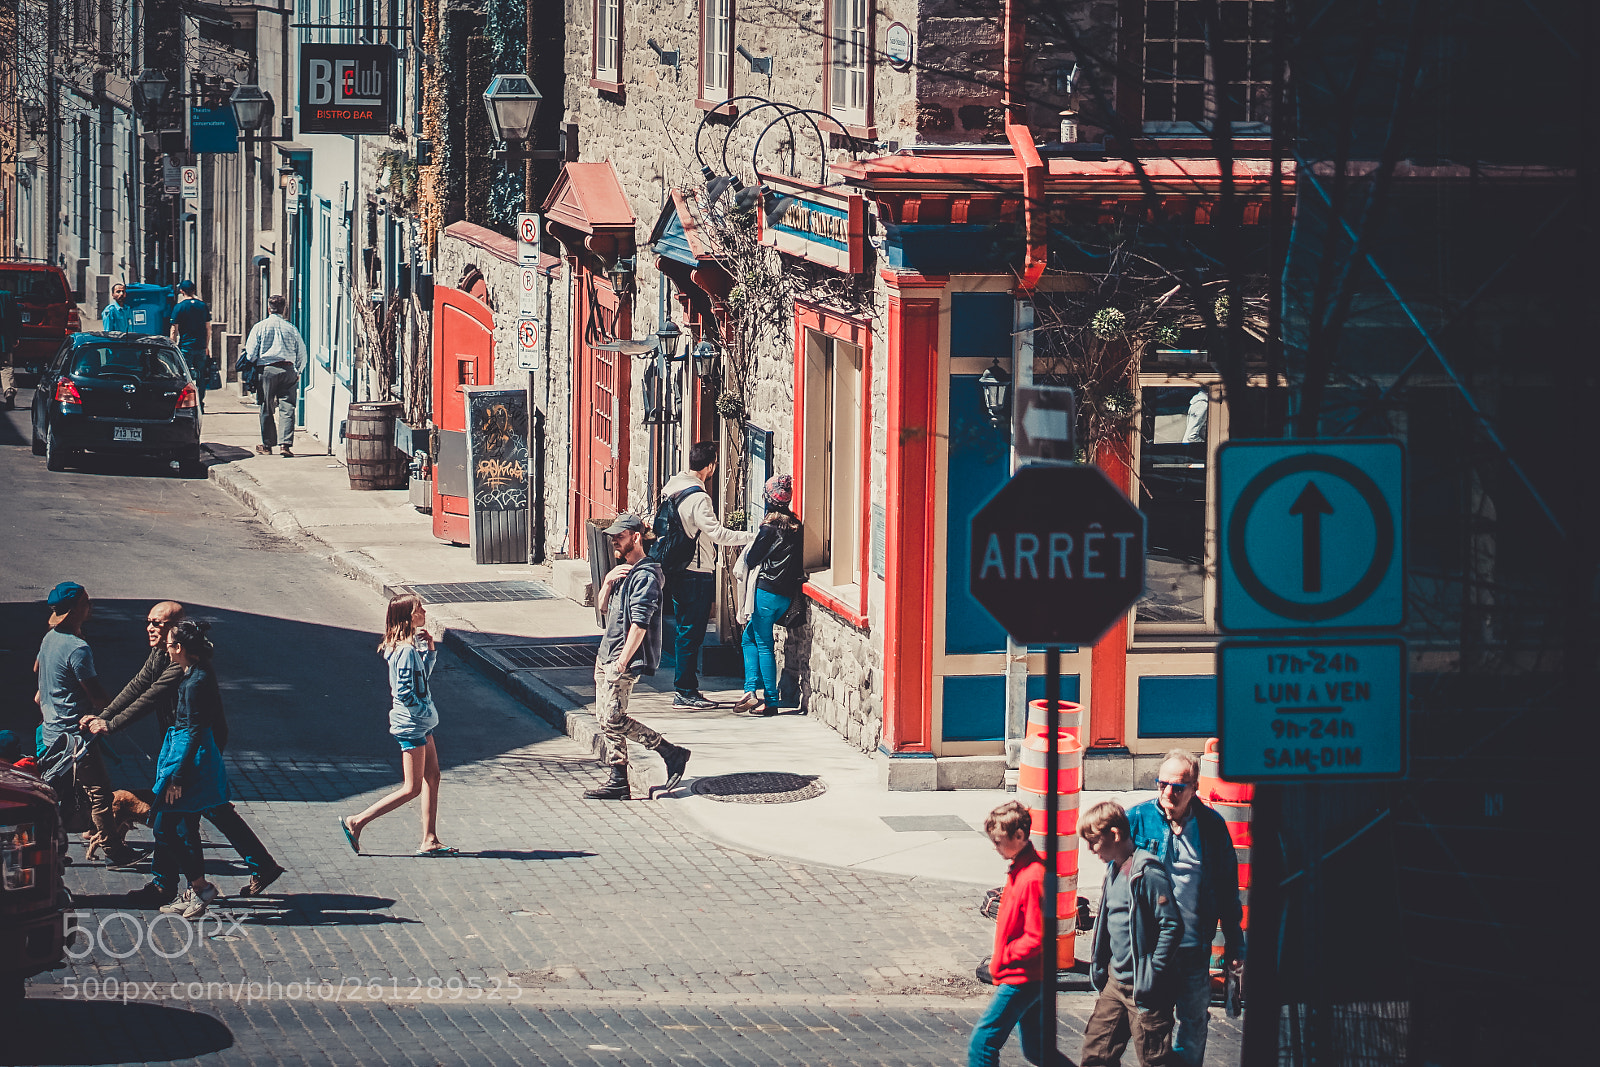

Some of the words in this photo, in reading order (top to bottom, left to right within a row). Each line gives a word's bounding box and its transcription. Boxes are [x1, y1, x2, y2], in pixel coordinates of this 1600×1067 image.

[317, 110, 351, 119] BISTRO
[353, 110, 373, 119] BAR
[979, 522, 1135, 579] ARRÊT
[1268, 652, 1358, 673] 17h-24h
[1254, 683, 1300, 703] LUN
[1325, 682, 1371, 702] VEN
[1271, 719, 1355, 739] 9h-24h
[1264, 748, 1361, 768] SAM-DIM
